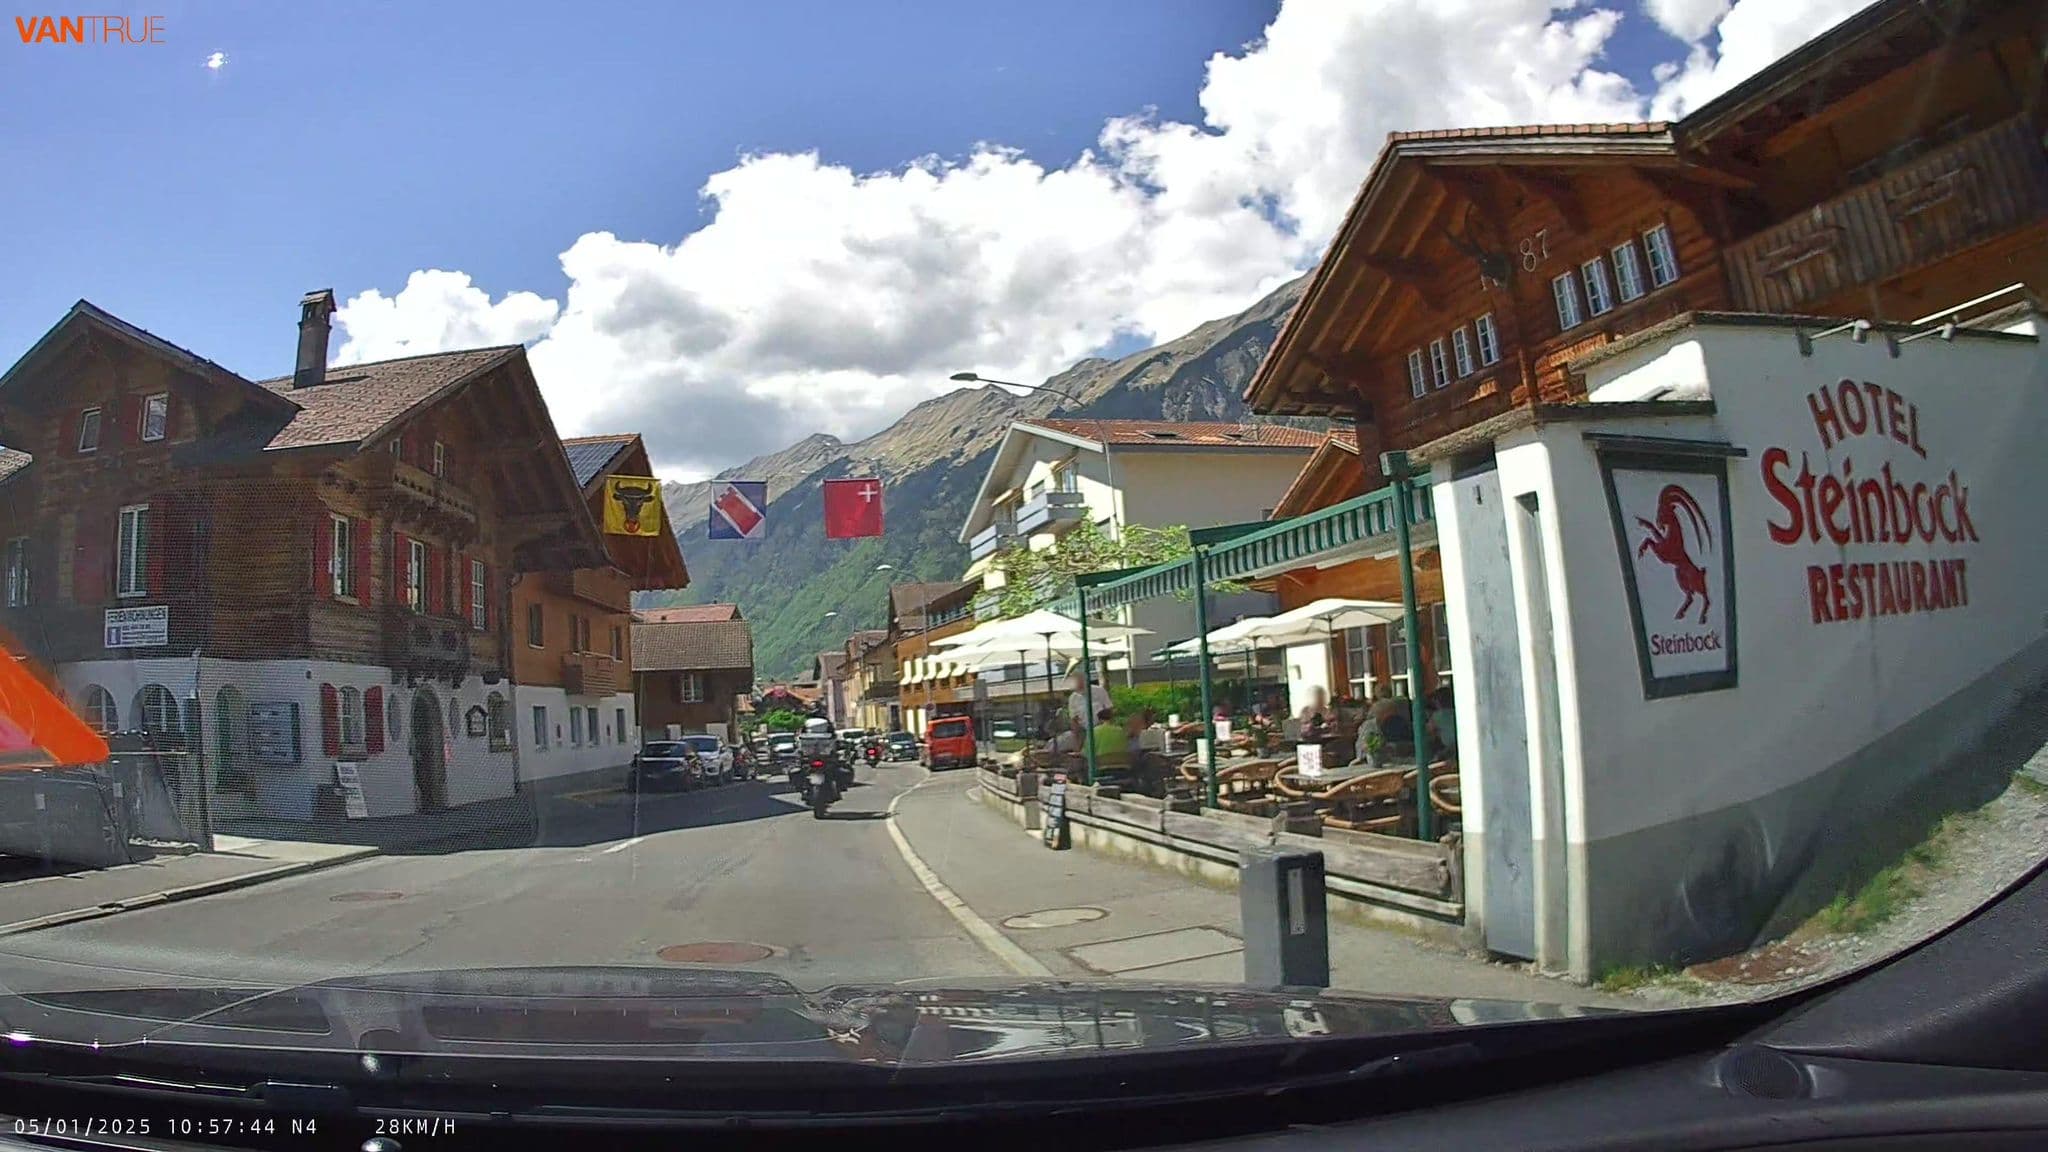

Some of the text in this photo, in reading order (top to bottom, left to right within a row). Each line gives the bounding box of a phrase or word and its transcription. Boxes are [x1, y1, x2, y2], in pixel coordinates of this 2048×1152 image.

[1806, 379, 1927, 460] HOTEL
[1760, 447, 1980, 545] Steinbock
[1806, 558, 1969, 624] RESTAURANT
[1651, 630, 1721, 656] Steinbock
